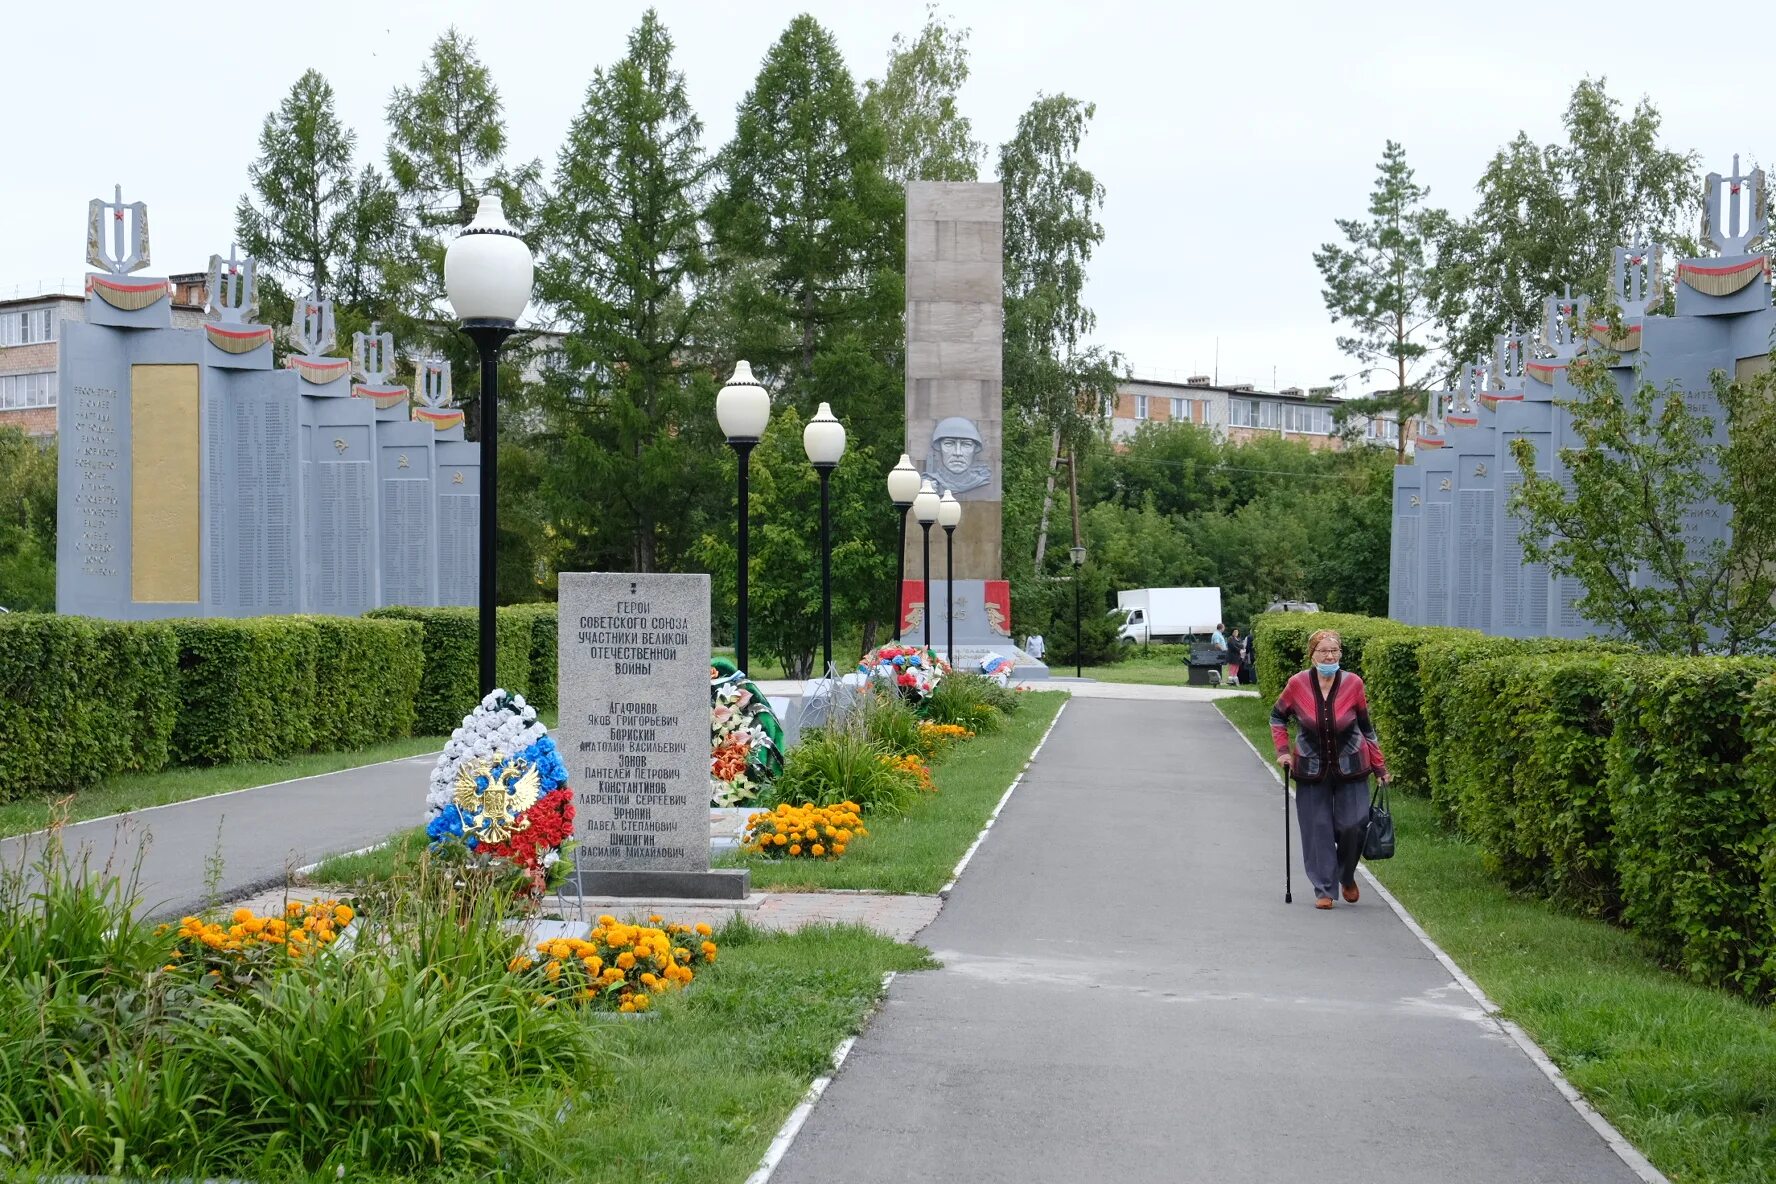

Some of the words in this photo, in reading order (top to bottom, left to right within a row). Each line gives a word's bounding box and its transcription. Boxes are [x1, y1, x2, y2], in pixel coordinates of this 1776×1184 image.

[617, 602, 650, 614] ГЕРОИ
[580, 617, 647, 630] СОВЕТСКОГО
[652, 618, 688, 630] СОЮЗА
[578, 632, 638, 644] УЧАСТНИКИ
[642, 632, 688, 646] ВЕЛИКОЙ
[590, 647, 676, 660] ОТЕЧЕСТВЕННОЙ
[615, 662, 651, 675] ВОЙНЫ
[609, 702, 658, 714] АГАФОНОВ
[588, 714, 611, 726] ЯКОВ
[616, 715, 678, 726] ГРИГОРЬЕВИЧ
[610, 728, 656, 741] БОРИСКИН
[580, 742, 625, 752] АНАТОЛИЙ
[630, 742, 686, 753] ВАСИЛЬЕВИЧ
[618, 754, 647, 768] ЗОНОВ
[584, 767, 631, 779] ПАНТЕЛЕЙ
[634, 768, 680, 780] ПЕТРОВИЧ
[598, 780, 666, 794] КОНСТАНТИНОВ
[580, 794, 630, 805] ЛАВРЕНТИЙ
[636, 794, 687, 806] СЕРГЕЕВИЧ
[614, 807, 651, 820] УРЮПИН
[588, 820, 616, 832] ПАВЕЛ
[621, 820, 678, 832] СТЕПАНОВИЧ
[610, 833, 655, 846] ШИШИГИН
[581, 846, 621, 858] ВАСИЛИЙ
[626, 846, 684, 858] МИХАЙЛОВИЧ
